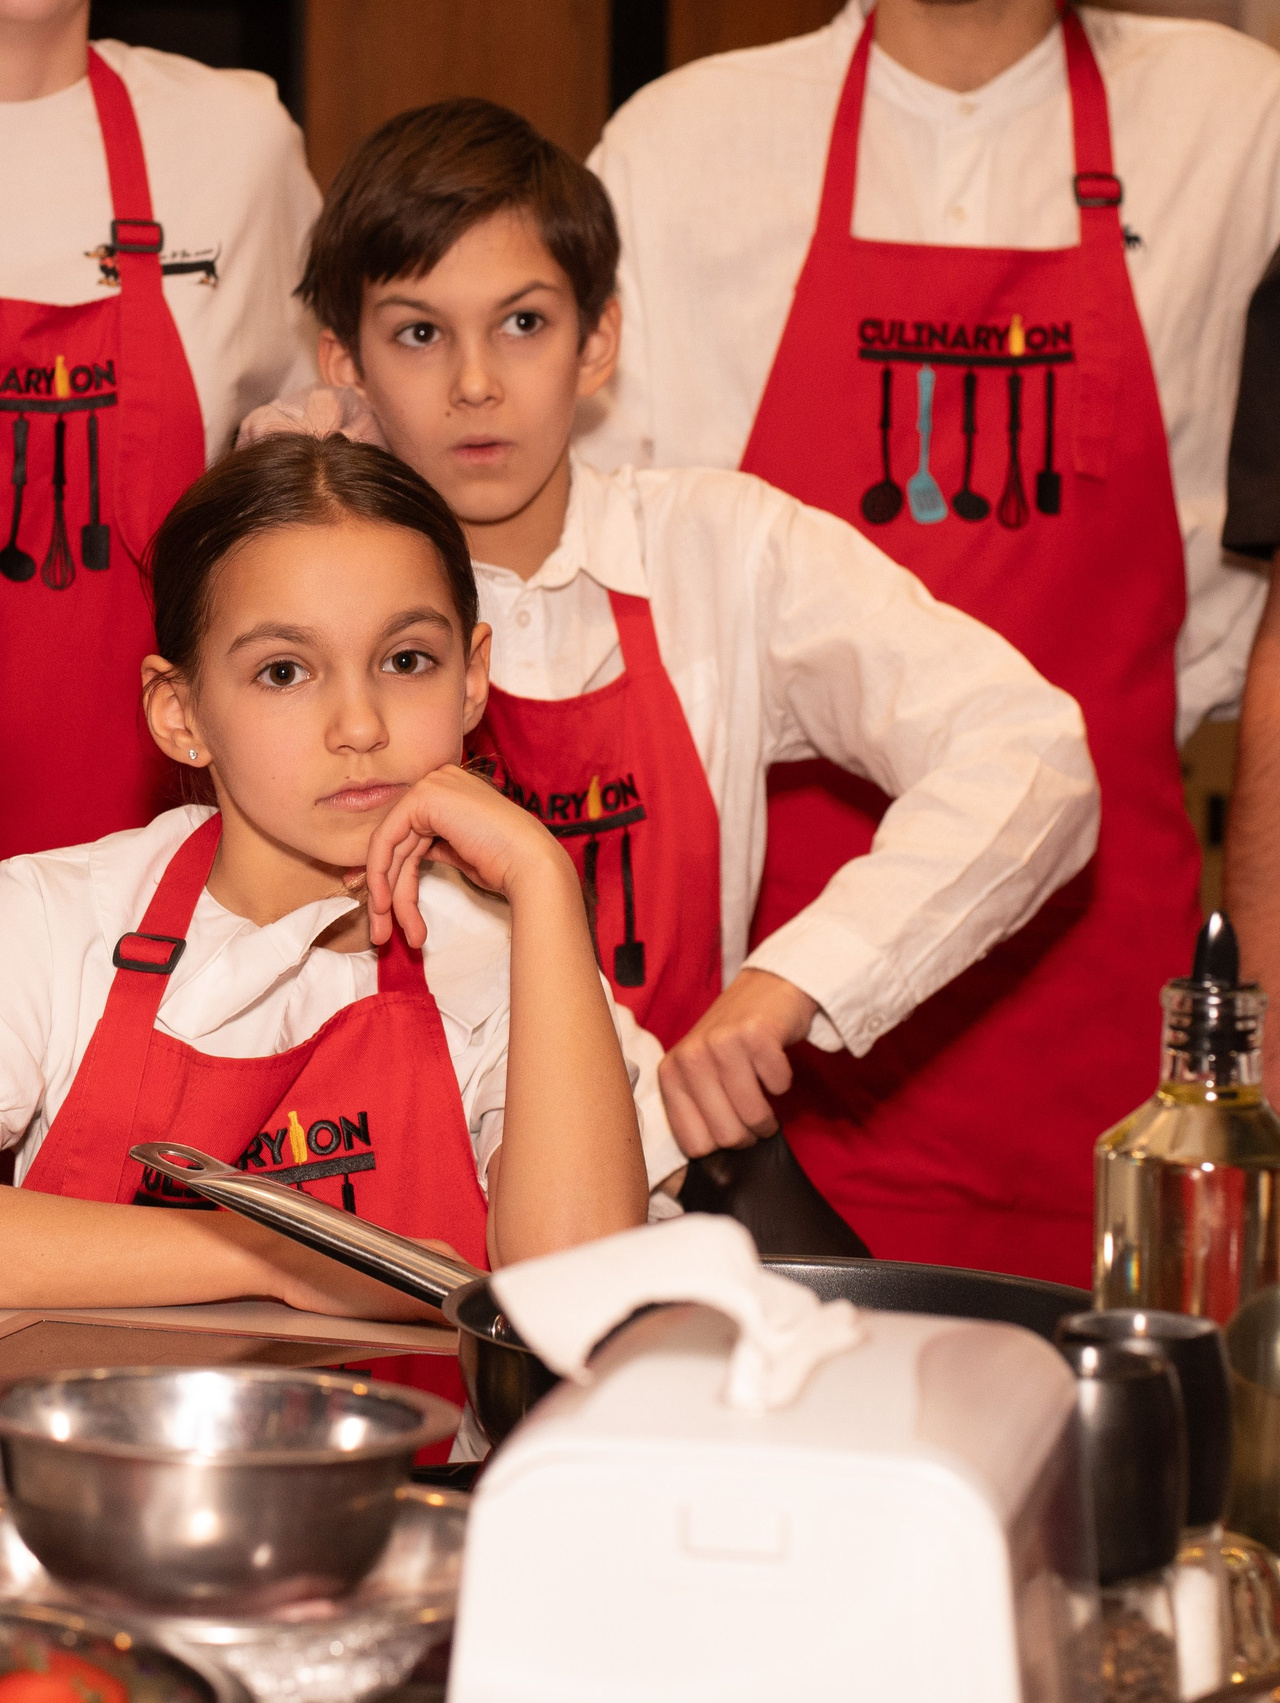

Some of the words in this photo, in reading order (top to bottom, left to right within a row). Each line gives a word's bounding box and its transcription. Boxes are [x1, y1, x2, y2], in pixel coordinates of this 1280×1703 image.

[859, 319, 1010, 350] CULINARY
[1026, 322, 1071, 350] ON
[71, 360, 117, 393] ON
[601, 773, 639, 812] ON
[307, 1111, 372, 1156] ON
